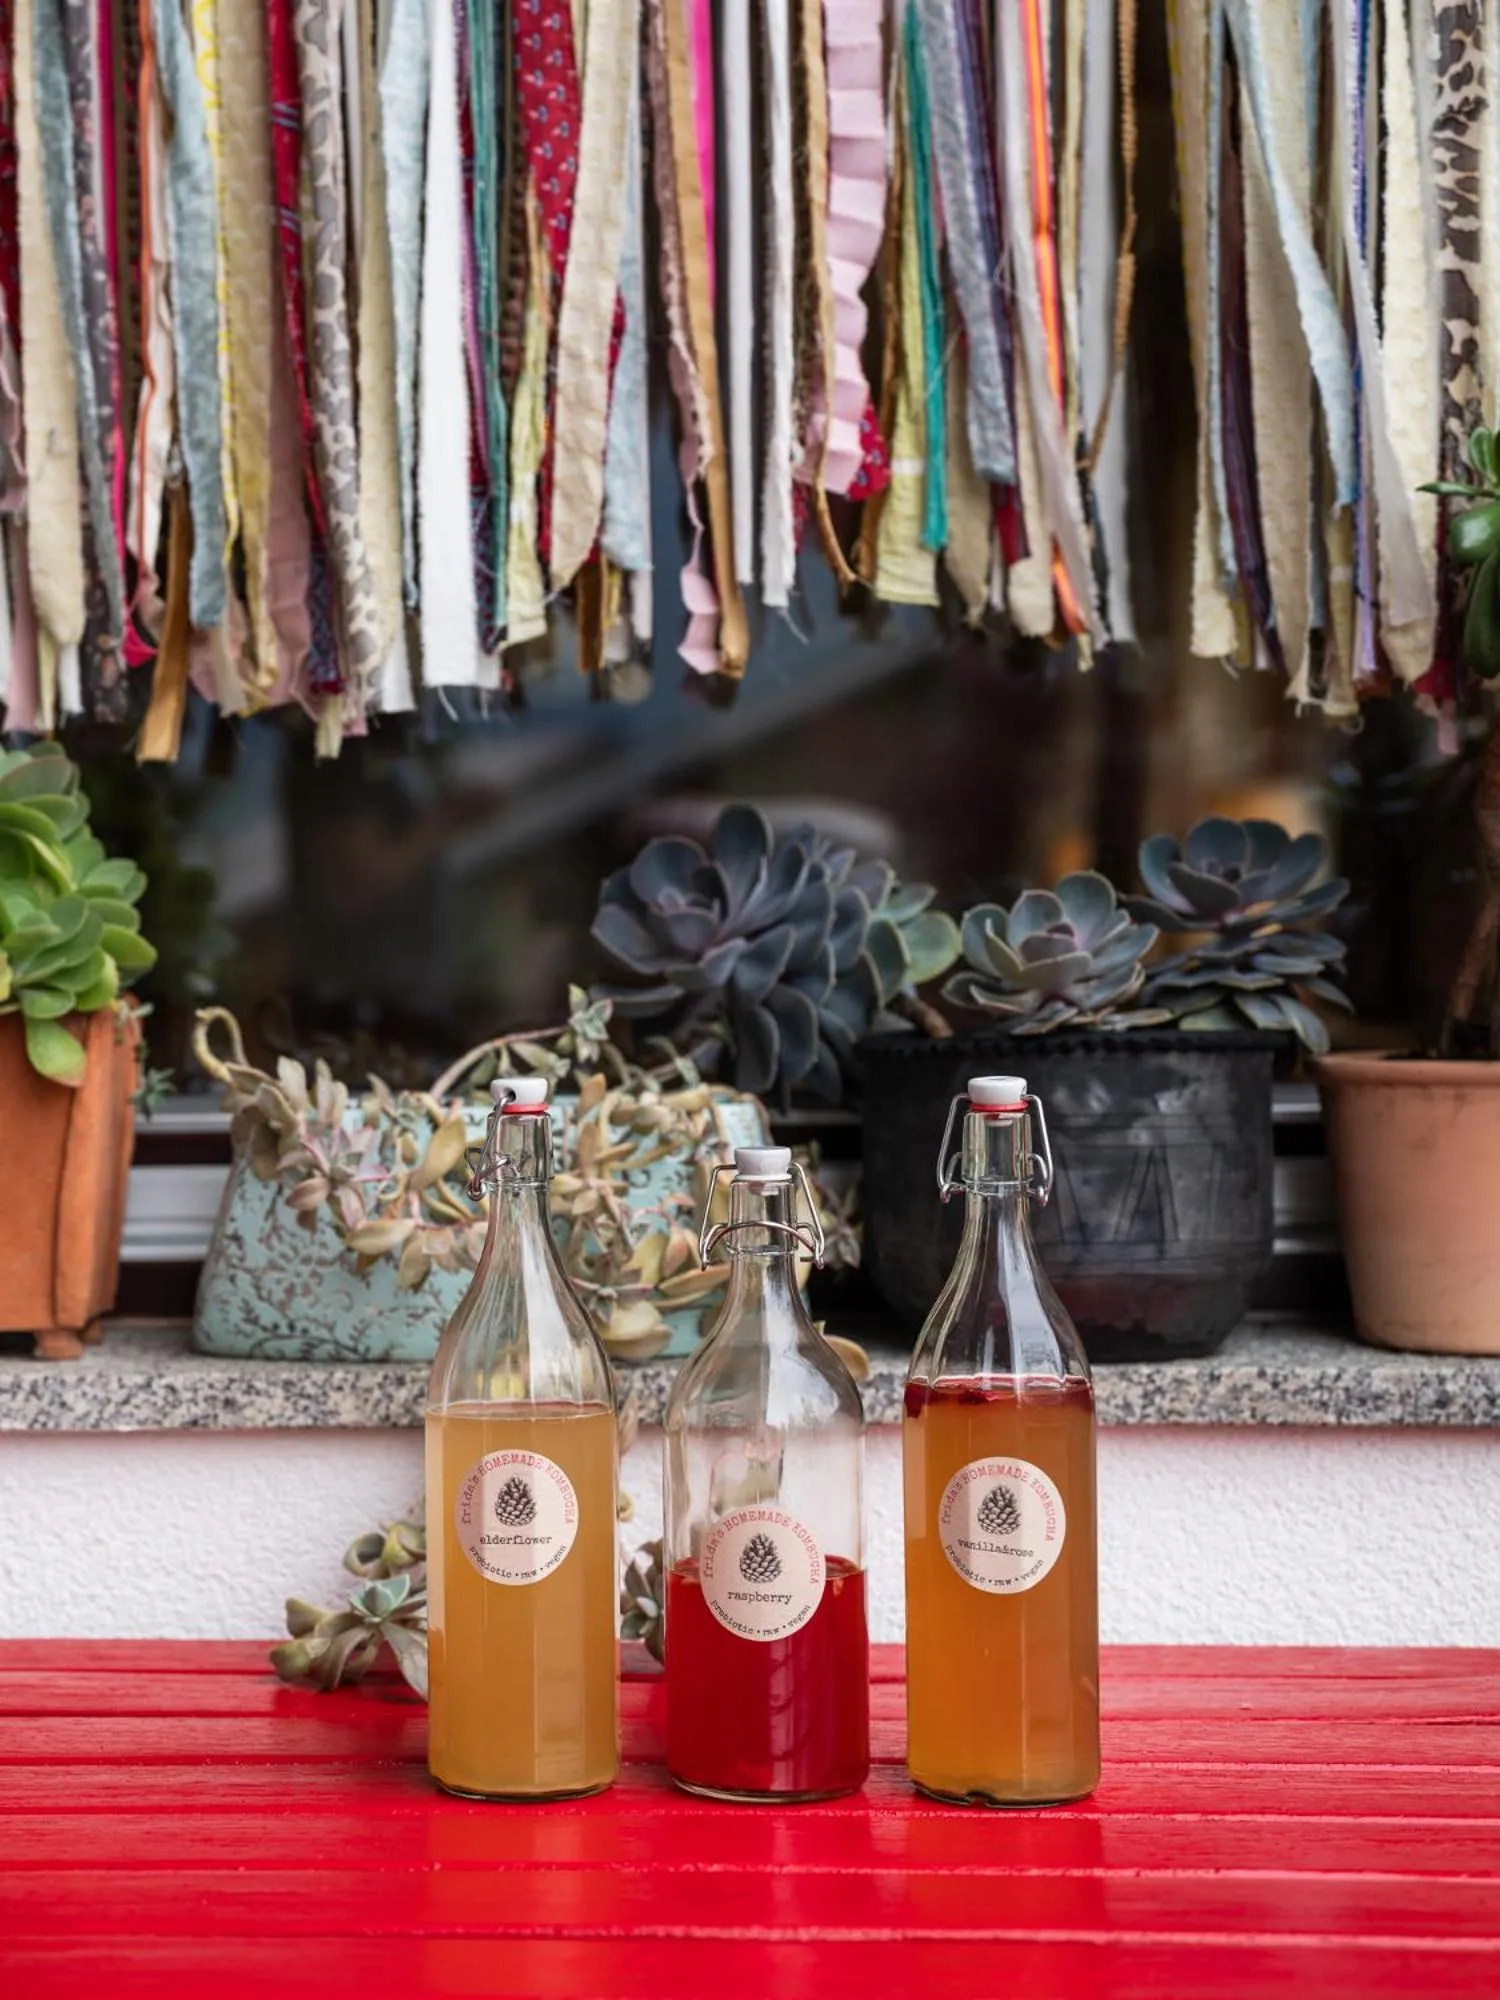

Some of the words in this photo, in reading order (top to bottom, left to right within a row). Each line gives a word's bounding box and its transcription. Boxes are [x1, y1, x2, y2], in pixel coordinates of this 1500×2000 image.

[478, 1453, 545, 1477] HOMEMADE
[544, 1465, 576, 1525] KOMBUCHA
[962, 1464, 1030, 1485] HOMEMADE
[1030, 1478, 1057, 1542] KOMBUCHA
[480, 1535, 552, 1545] elderflower
[723, 1510, 791, 1532] HOMEMADE
[792, 1523, 821, 1584] KOMBUCHA
[958, 1539, 1034, 1557] vanilla&rose
[469, 1546, 512, 1578] probiotic
[521, 1571, 537, 1579] raw
[545, 1545, 567, 1568] vegan
[946, 1544, 985, 1583] probiotic
[1020, 1559, 1044, 1580] vegan
[727, 1591, 793, 1605] raspberry
[711, 1600, 754, 1634] probiotic
[763, 1628, 780, 1636] raw
[788, 1605, 811, 1628] vegan
